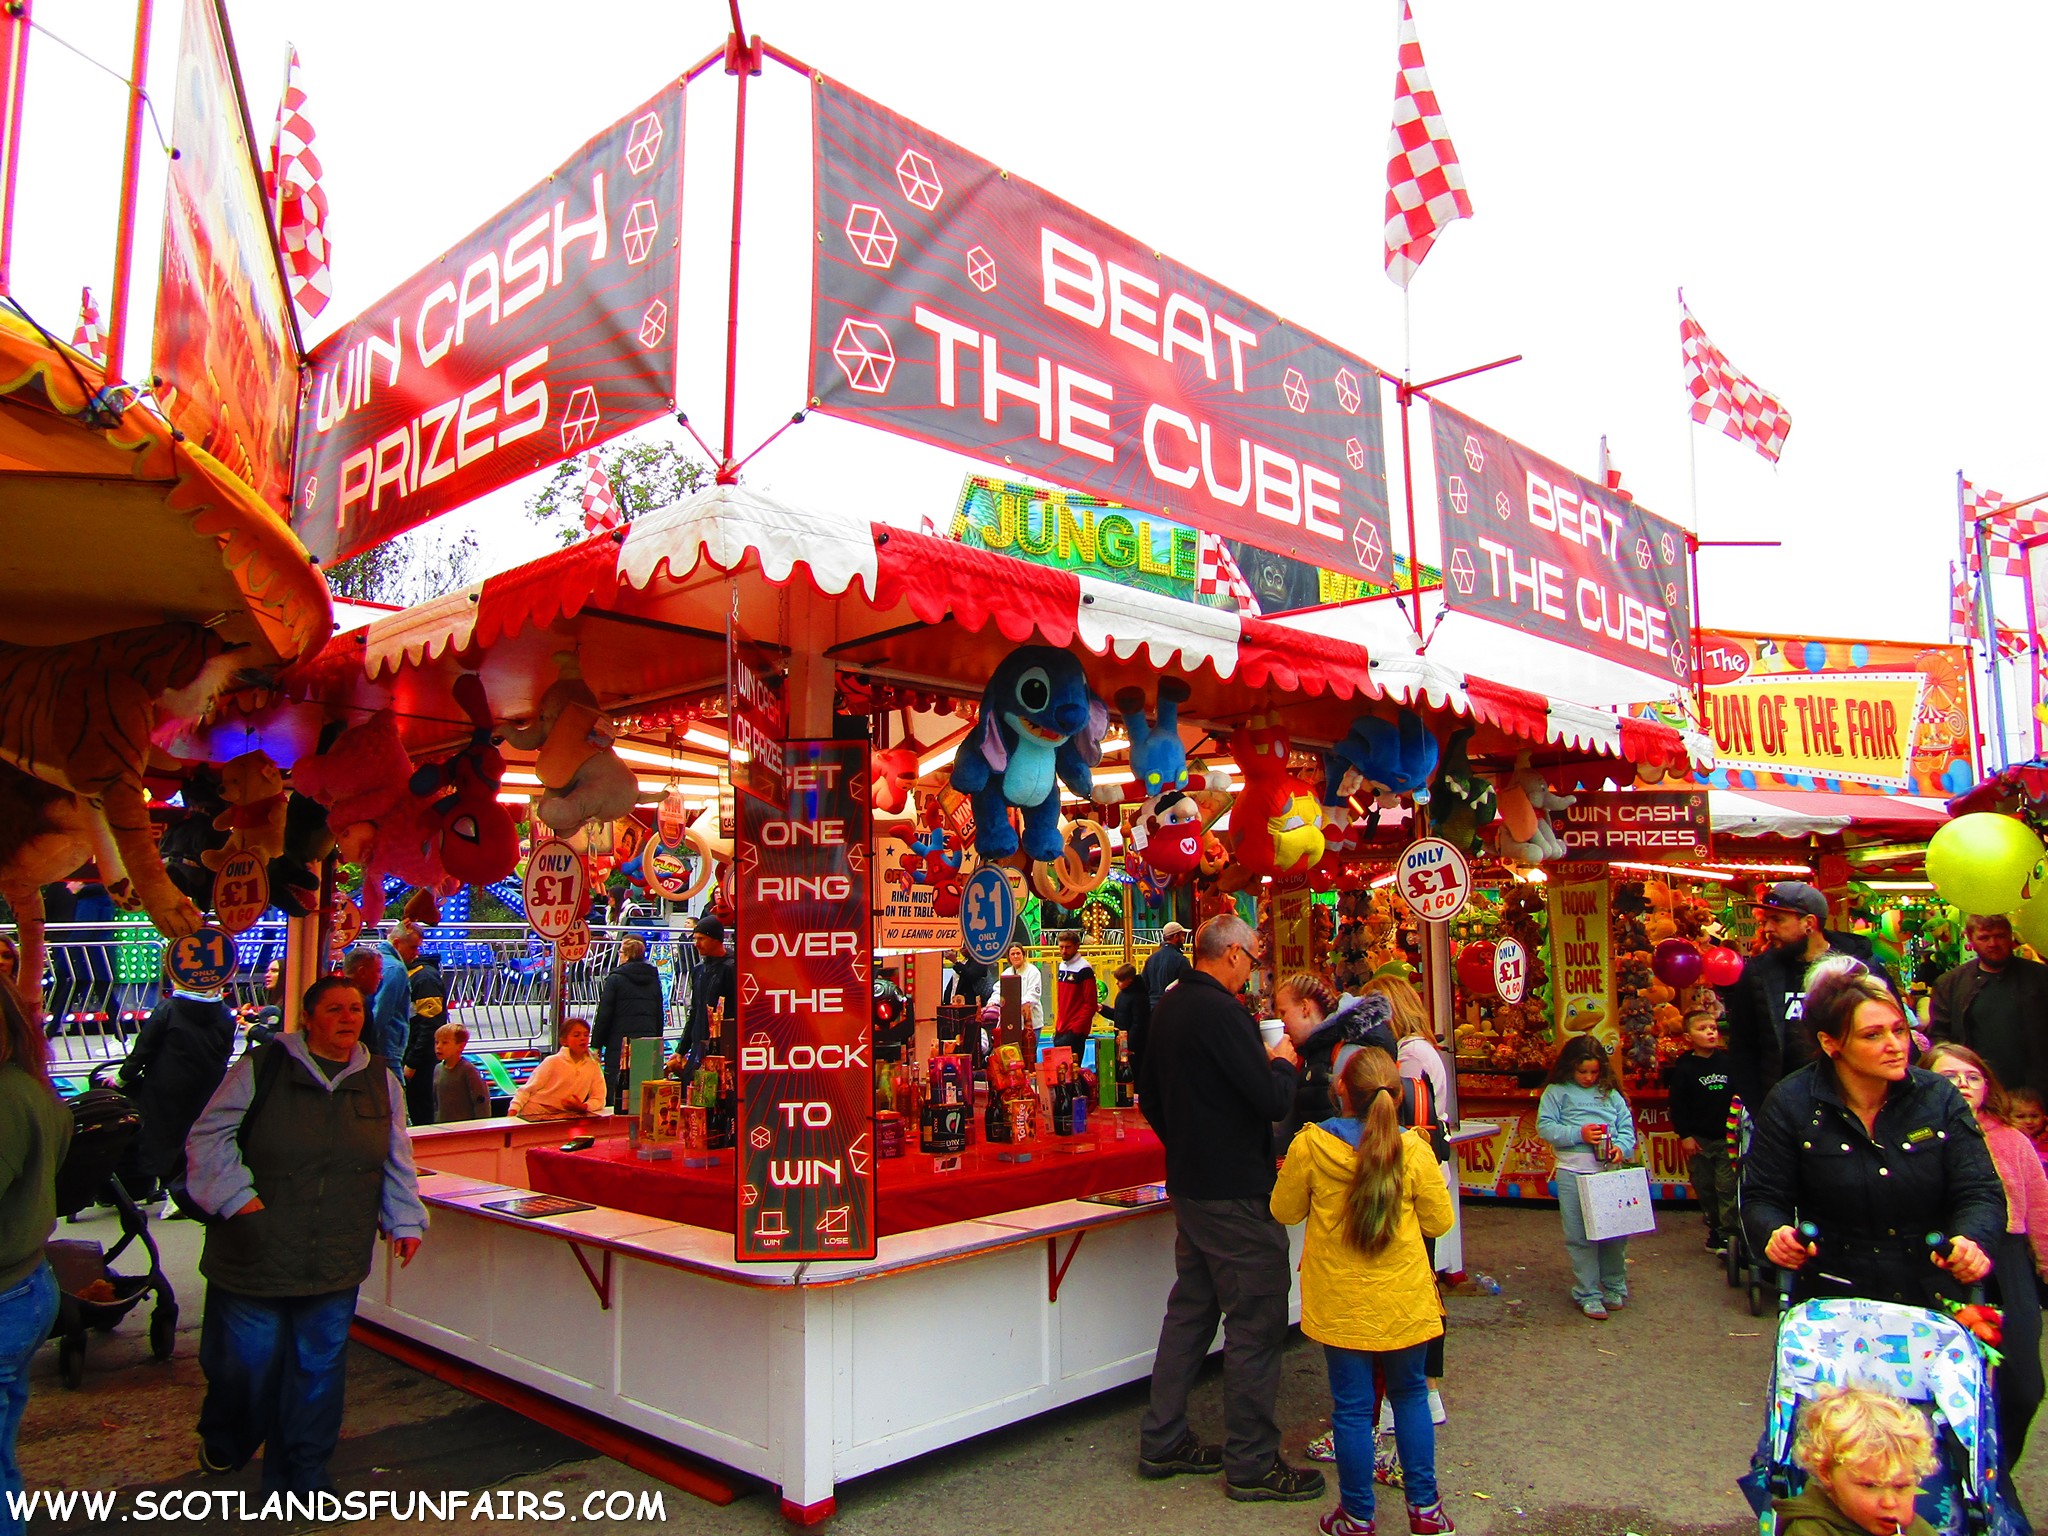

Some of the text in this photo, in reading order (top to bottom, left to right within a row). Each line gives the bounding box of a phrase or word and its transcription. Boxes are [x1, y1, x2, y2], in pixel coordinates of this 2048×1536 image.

[317, 173, 608, 432] WIN CASH
[1040, 226, 1257, 393] BEAT
[914, 305, 1344, 541] THE CUBE
[337, 345, 550, 529] PRIZES
[1525, 469, 1624, 563] BEAT
[981, 494, 1197, 581] JUNGLE
[1477, 535, 1567, 621] THE
[1575, 576, 1667, 656] CUBE
[1706, 647, 1746, 674] The
[738, 658, 756, 706] WIN
[1758, 694, 1788, 756] OF
[1794, 694, 1844, 757] THE
[1845, 698, 1901, 760] FAIR
[736, 713, 783, 776] OR PRIZES
[786, 765, 842, 789] ET
[1567, 805, 1690, 822] WIN CASH
[762, 820, 845, 845] ONE
[961, 818, 976, 836] CAS
[1563, 830, 1696, 847] OR PRIZES
[226, 860, 255, 878] ONLY
[539, 854, 573, 873] ONLY
[653, 858, 682, 873] PLAY
[1407, 846, 1444, 869] ONLY
[219, 878, 262, 907] £1
[531, 875, 575, 907] £1
[757, 876, 850, 902] RING
[1408, 863, 1462, 899] £1
[891, 890, 933, 903] RING MUST
[968, 881, 1003, 931] £1
[1422, 892, 1455, 913] A GO
[1560, 889, 1598, 917] HOOK
[227, 907, 254, 924] A GO
[541, 909, 569, 927] A GO
[885, 905, 935, 917] ON THE TABLE
[559, 930, 587, 947] £1
[901, 929, 934, 939] LEANING
[978, 932, 997, 942] ONLY
[1575, 916, 1586, 942] A
[178, 934, 224, 971] £1
[573, 948, 584, 956] GO
[750, 931, 858, 958] OVER
[975, 941, 1000, 952] A GO
[1281, 944, 1305, 968] DUCK
[1499, 944, 1516, 961] ONLY
[1564, 941, 1601, 967] DUCK
[186, 975, 221, 985] A GO
[1499, 959, 1522, 984] £1
[1564, 968, 1604, 995] GAME
[765, 988, 844, 1014] THE
[1505, 982, 1520, 996] A GO
[741, 1044, 869, 1071] BLOCK
[778, 1102, 832, 1128] TO
[1016, 1103, 1027, 1142] Toffifee
[1637, 1108, 1657, 1125] All
[946, 1139, 960, 1147] LYNX
[770, 1159, 841, 1186] WIN
[824, 1237, 849, 1245] LOSE
